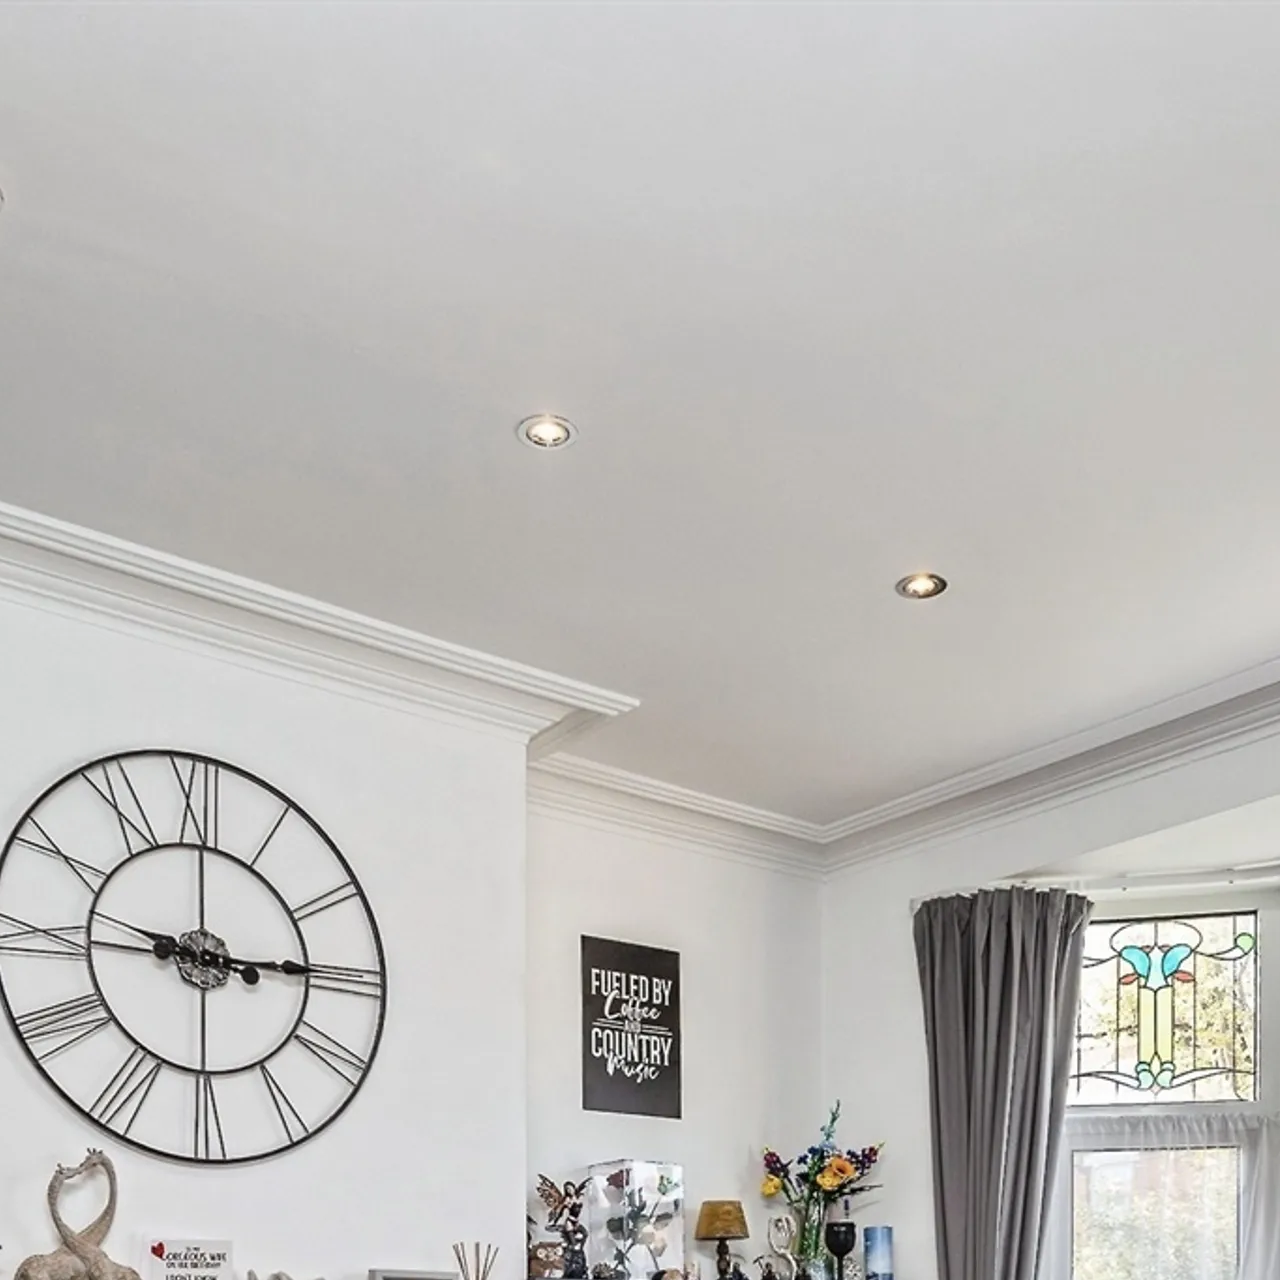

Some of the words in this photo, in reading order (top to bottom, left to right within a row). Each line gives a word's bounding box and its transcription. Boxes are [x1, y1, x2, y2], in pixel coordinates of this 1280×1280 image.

[81, 759, 159, 857] XI
[170, 754, 219, 849] XII
[15, 815, 109, 893] X
[292, 881, 361, 921] II
[591, 968, 649, 1002] FUELED
[652, 977, 673, 1006] BY
[604, 990, 662, 1021] Coffee
[591, 1027, 673, 1066] COUNTRY
[606, 1051, 660, 1083] Music
[261, 1064, 310, 1143] V
